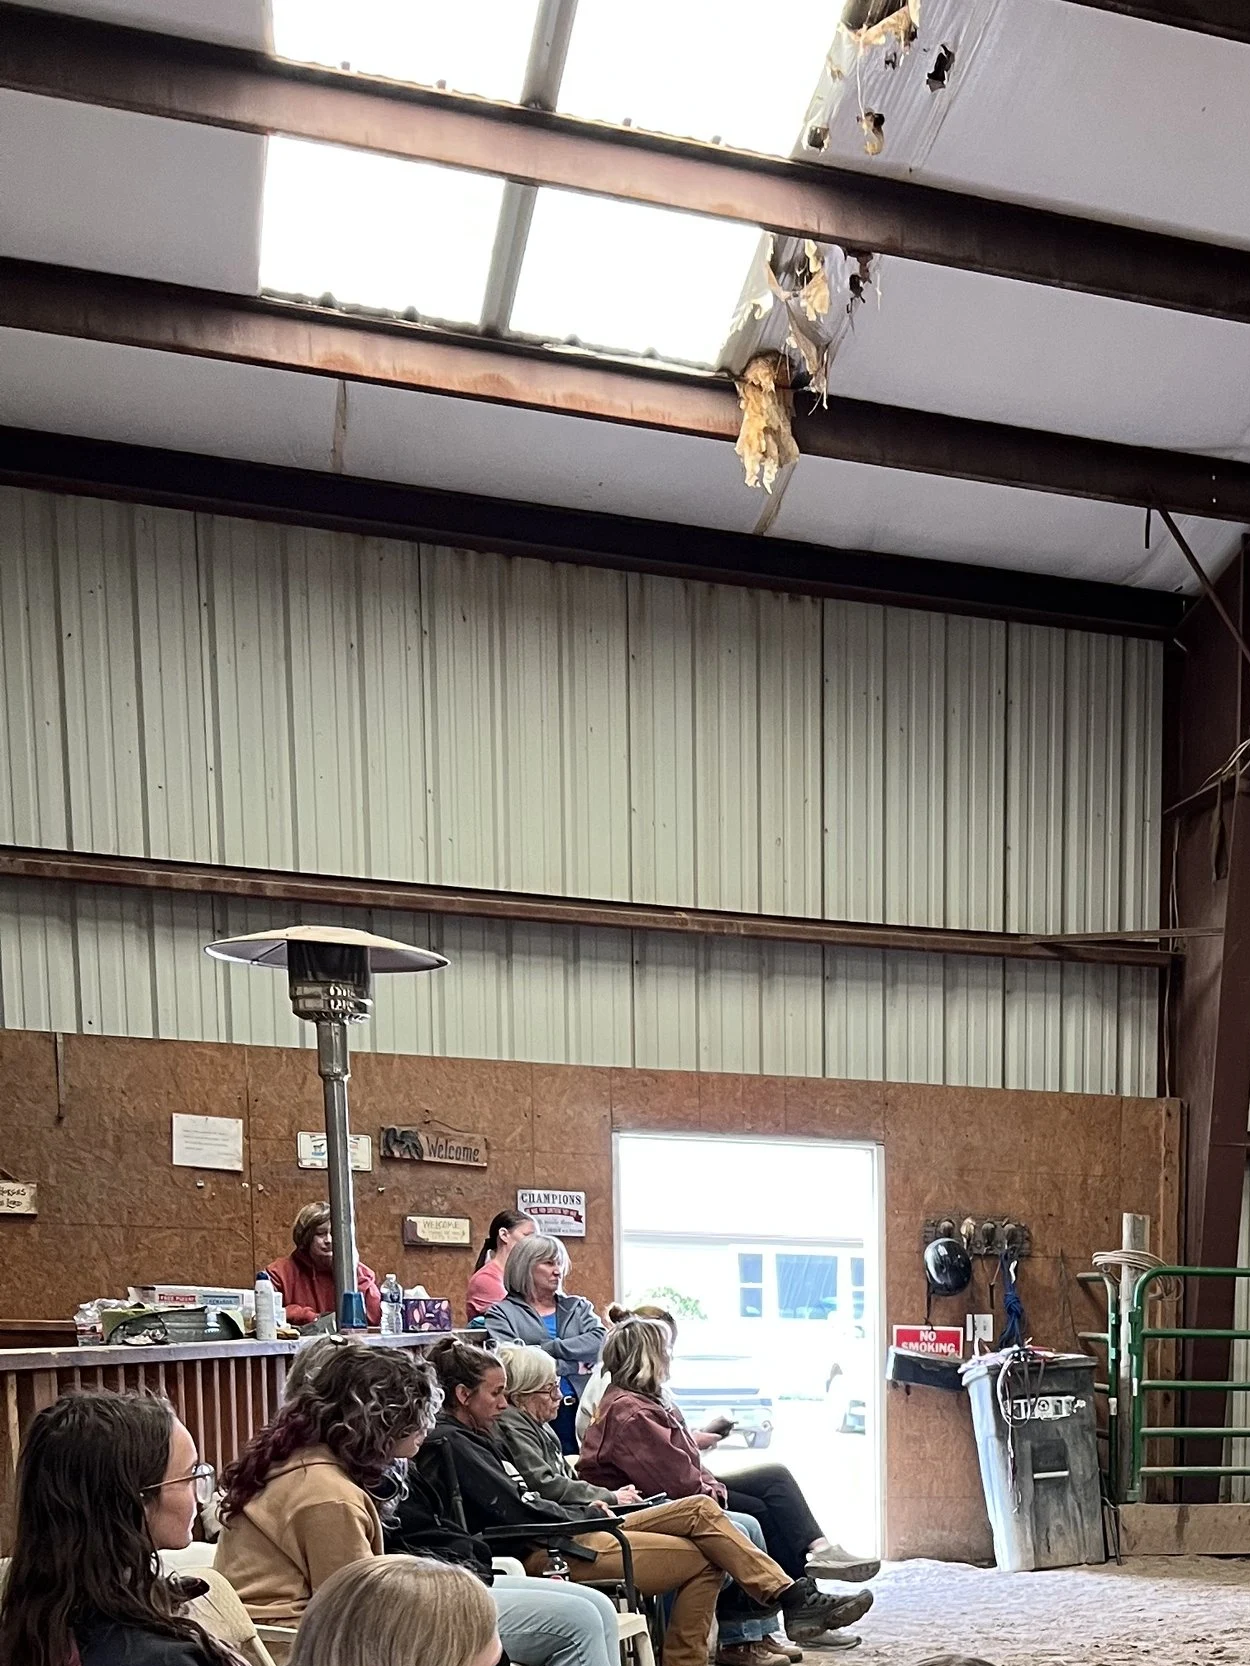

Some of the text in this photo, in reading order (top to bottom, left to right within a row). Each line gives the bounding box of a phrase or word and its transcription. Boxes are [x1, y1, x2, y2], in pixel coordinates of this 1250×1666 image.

[425, 1136, 480, 1162] Welcome
[521, 1193, 582, 1205] CHAMPIONS
[422, 1219, 459, 1230] WELCOME
[919, 1330, 937, 1342] NO
[901, 1341, 956, 1354] SMOKING
